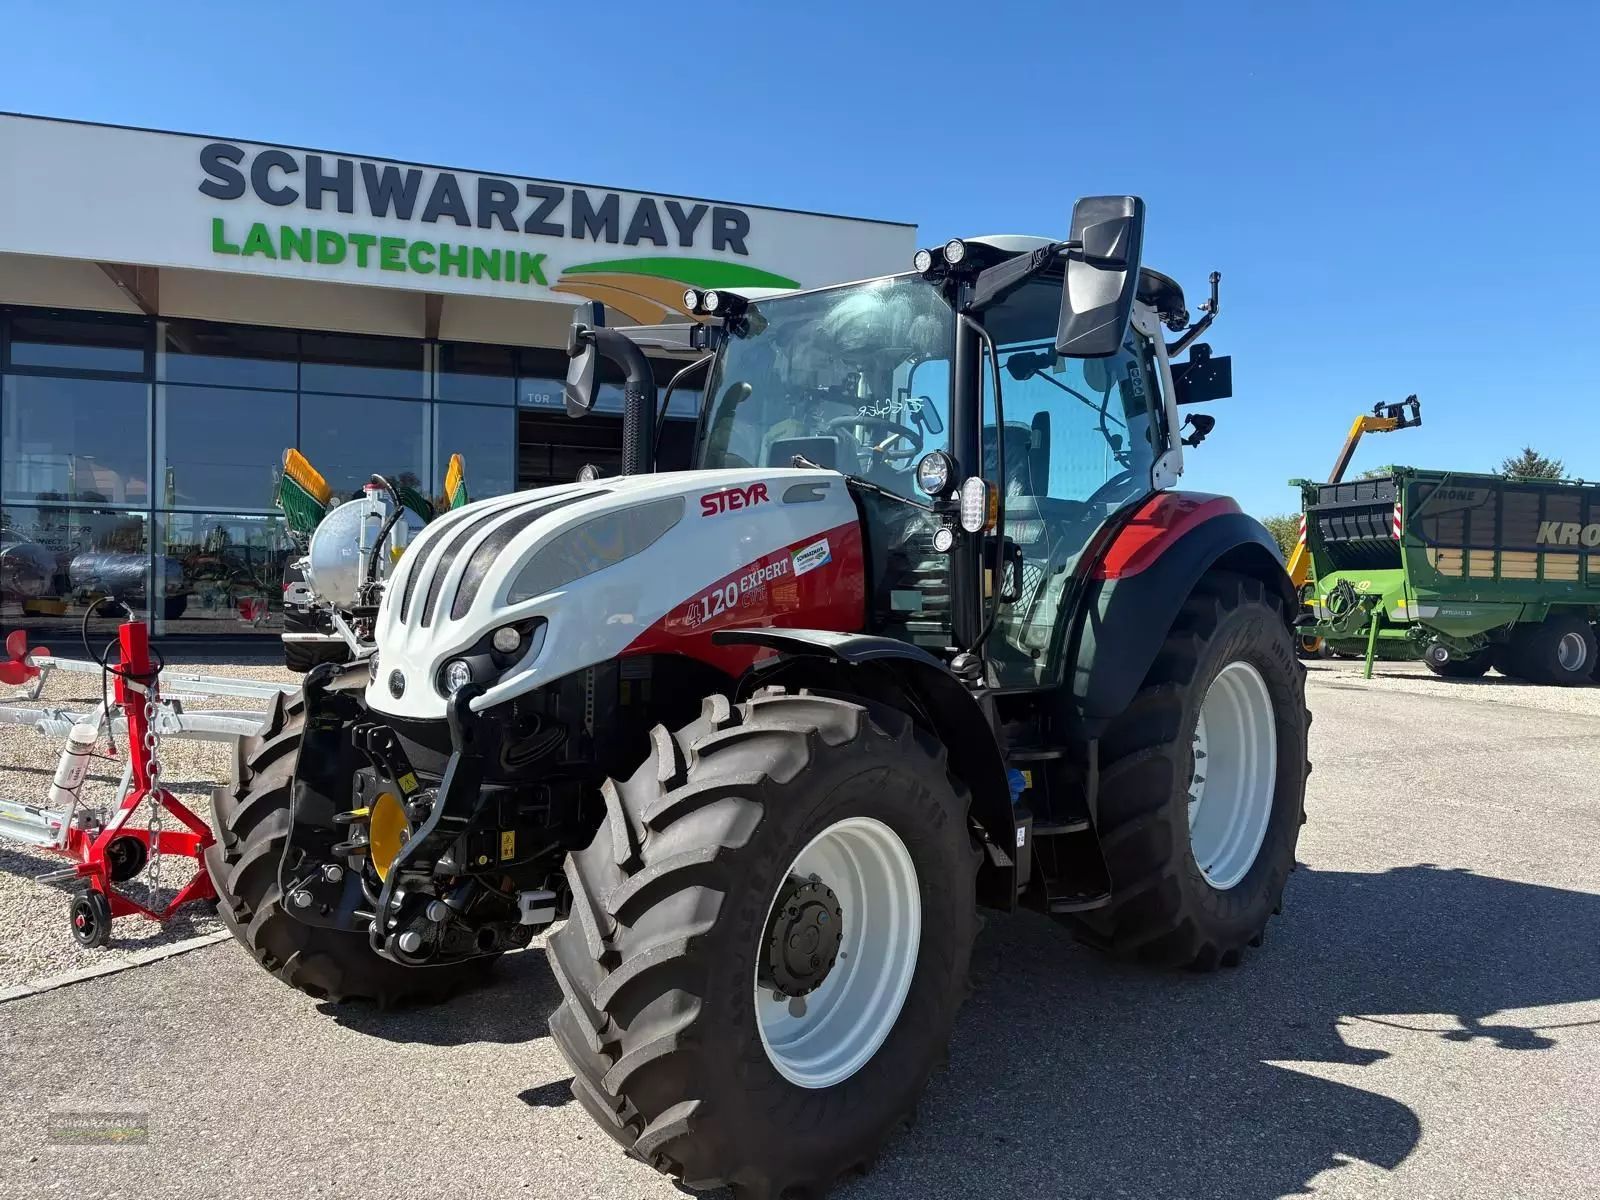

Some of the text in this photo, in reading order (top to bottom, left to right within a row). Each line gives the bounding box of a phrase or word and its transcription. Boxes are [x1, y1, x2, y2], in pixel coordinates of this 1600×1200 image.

[199, 143, 750, 255] SCHWARZMAYR
[212, 218, 549, 285] LANDTECHNIK
[528, 393, 550, 404] TOR
[700, 482, 769, 517] STEYR
[740, 558, 789, 592] EXPERT
